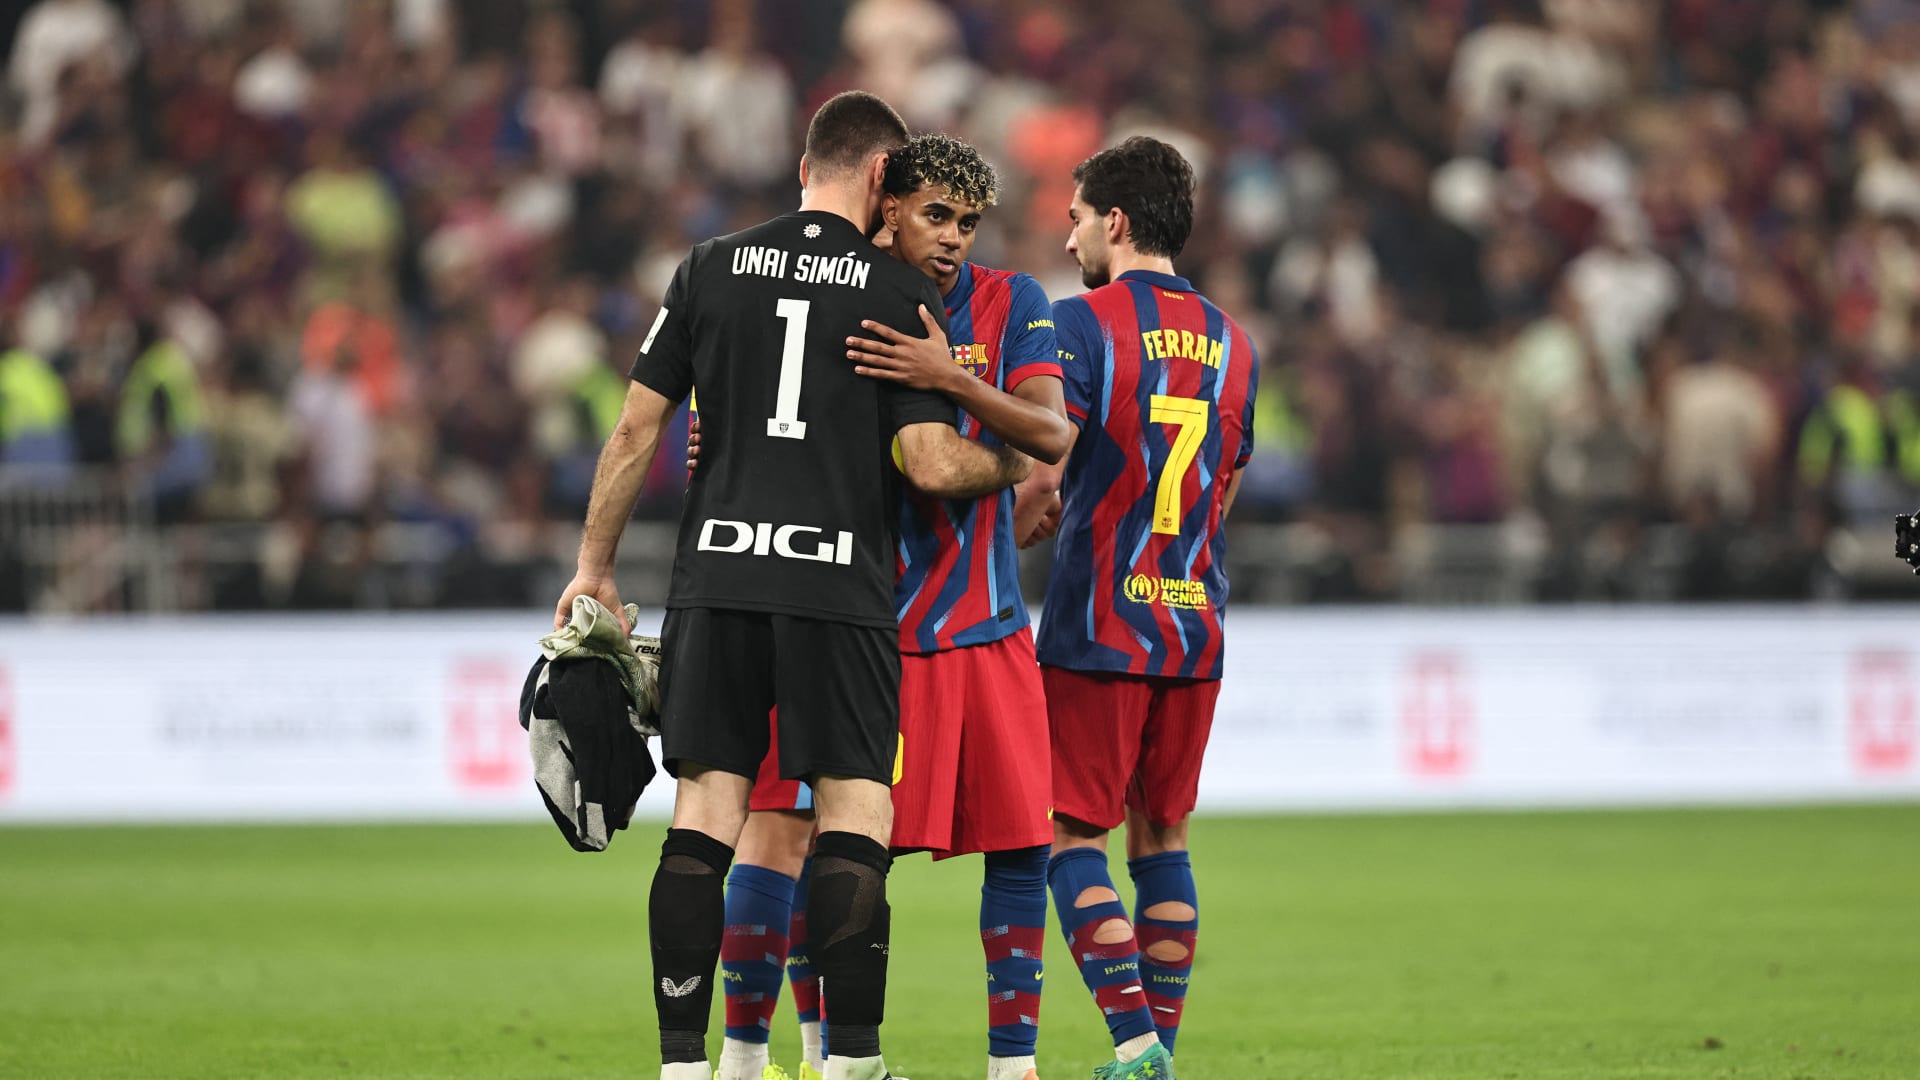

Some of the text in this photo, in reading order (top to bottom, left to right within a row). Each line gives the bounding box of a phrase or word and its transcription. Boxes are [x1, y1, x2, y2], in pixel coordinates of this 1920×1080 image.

[732, 246, 871, 289] UNAI SIMÓN
[767, 298, 810, 439] 1
[1142, 329, 1224, 370] FERRAN
[1150, 394, 1209, 535] 7
[697, 519, 853, 565] DIGI
[1160, 578, 1205, 593] UNHCR
[1160, 591, 1207, 605] ACNUR
[635, 645, 661, 655] reu
